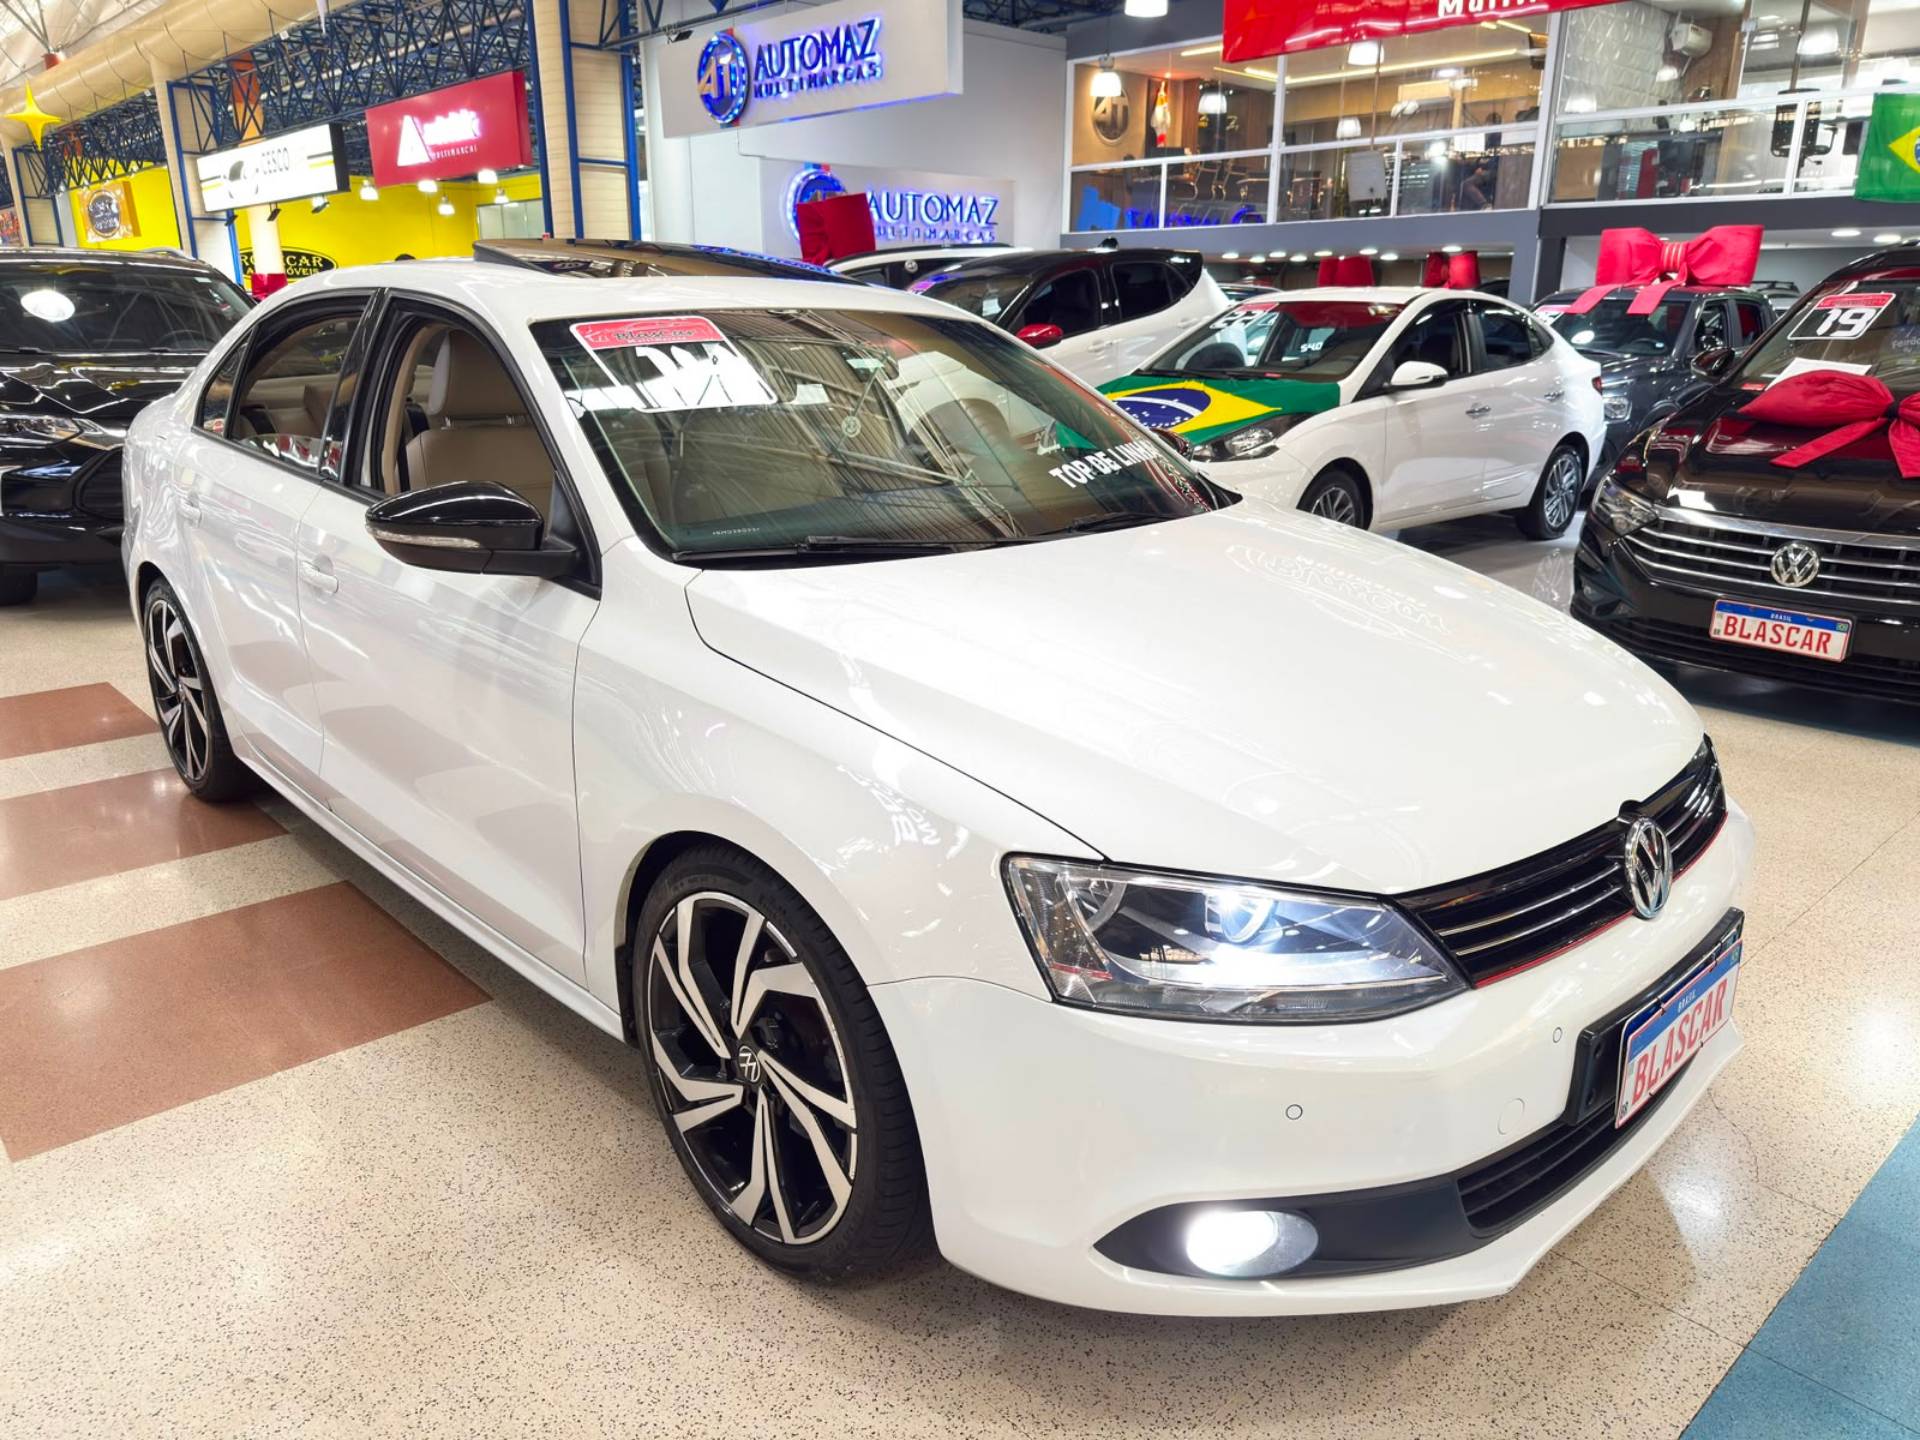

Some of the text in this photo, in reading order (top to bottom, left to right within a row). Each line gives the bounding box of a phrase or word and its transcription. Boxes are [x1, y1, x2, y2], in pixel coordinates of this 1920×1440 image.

[754, 18, 878, 81] AUTOMAZ
[753, 62, 878, 98] MULTIMARCAS
[868, 192, 999, 226] AUTOMAZ
[877, 226, 996, 242] ULTIMARCAS
[1815, 307, 1877, 337] 19
[1048, 459, 1095, 488] TOP
[1084, 451, 1122, 475] DE
[1723, 615, 1832, 654] BLASCAR
[1631, 977, 1729, 1105] BLASCAR
